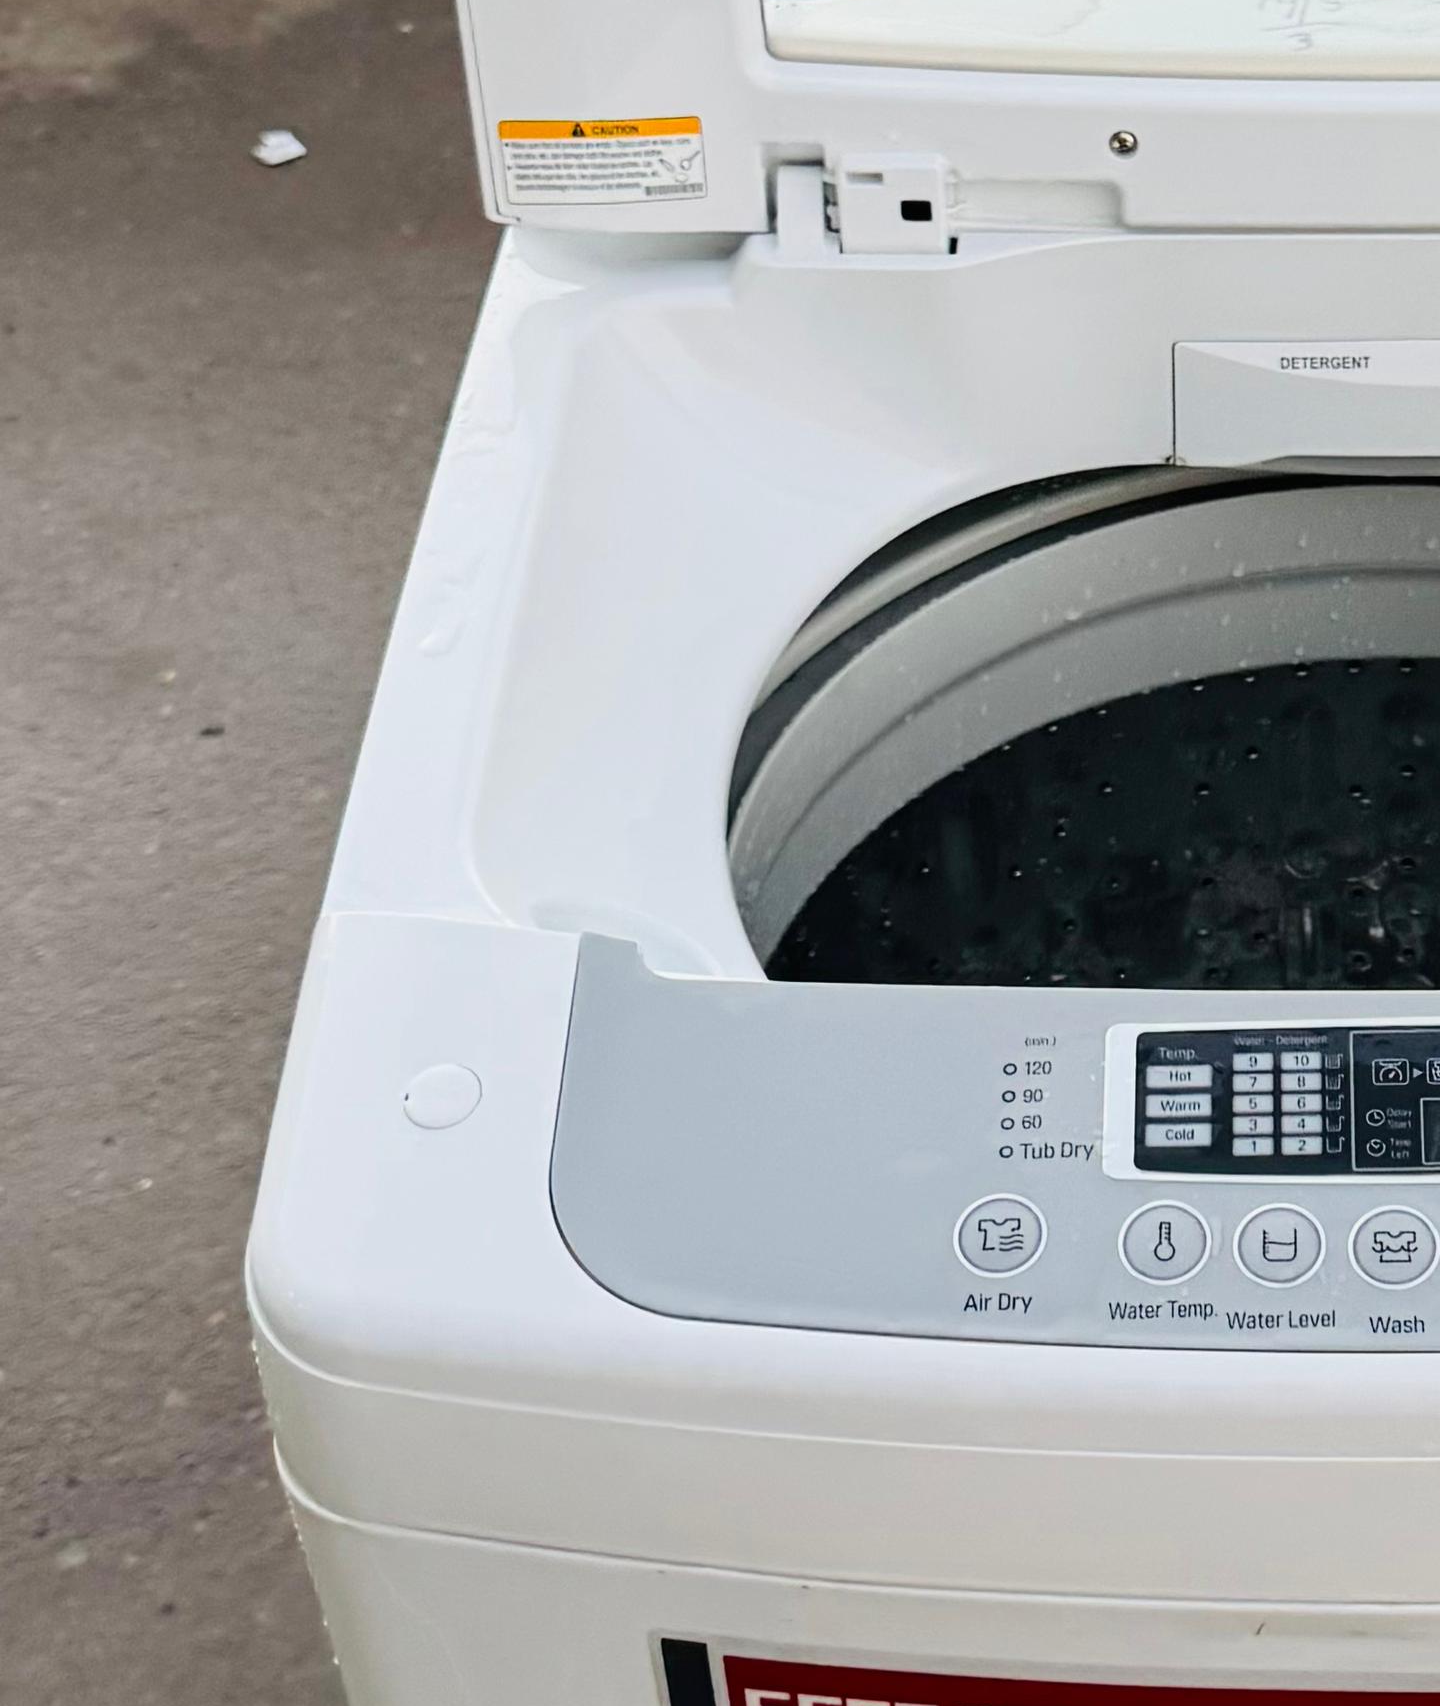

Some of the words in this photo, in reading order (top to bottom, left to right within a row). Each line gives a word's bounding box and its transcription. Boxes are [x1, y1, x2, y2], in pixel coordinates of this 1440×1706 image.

[592, 125, 639, 136] CAUTION
[1280, 356, 1371, 370] DETERGENT
[1025, 1061, 1053, 1075] 120
[1248, 1056, 1258, 1068] 9
[1294, 1055, 1310, 1067] 10
[1169, 1070, 1192, 1082] Hot
[1248, 1076, 1258, 1088] 7
[1297, 1076, 1306, 1088] 8
[1022, 1088, 1043, 1103] 90
[1160, 1099, 1201, 1111] Warm
[1248, 1097, 1258, 1109] 5
[1297, 1097, 1306, 1108] 6
[1021, 1115, 1042, 1130] 60
[1248, 1119, 1258, 1131] 3
[1297, 1118, 1306, 1130] 4
[1165, 1128, 1195, 1142] Cold
[1019, 1142, 1055, 1160] Tub
[1060, 1141, 1095, 1161] Dry
[1297, 1139, 1306, 1151] 2
[963, 1293, 991, 1313] Air
[998, 1293, 1032, 1314] Dry
[1108, 1301, 1162, 1321] Water
[1167, 1300, 1219, 1321] Temp.
[1226, 1311, 1283, 1331] Water
[1288, 1309, 1337, 1329] Level
[1369, 1315, 1426, 1335] Wash
